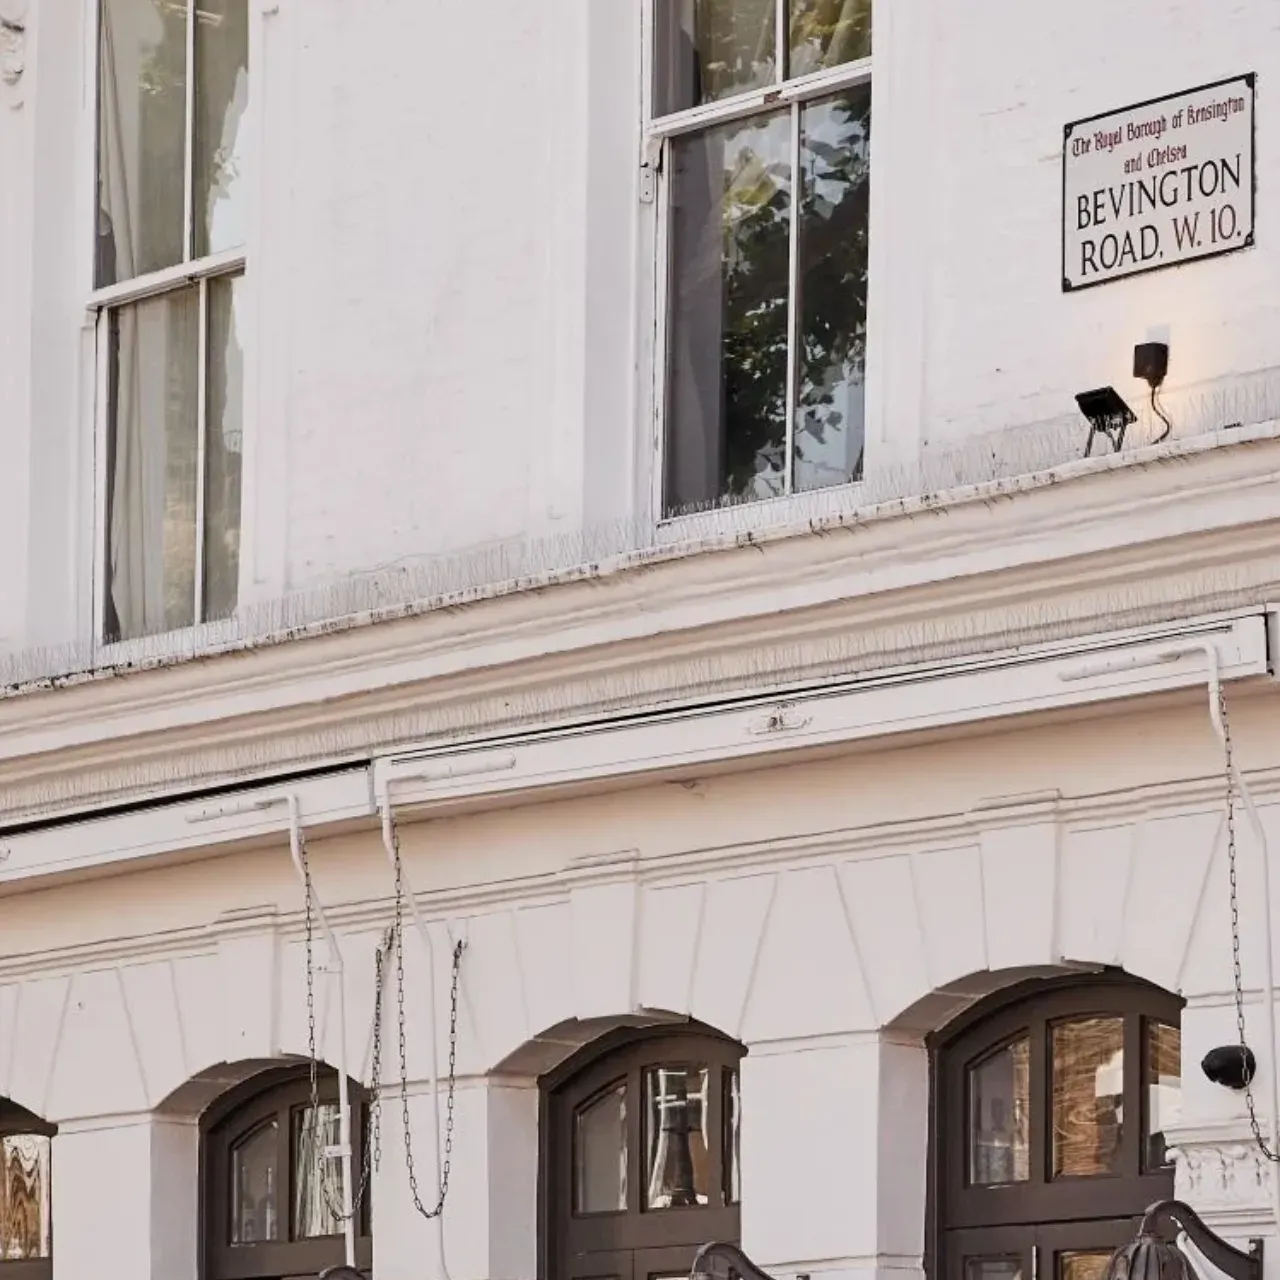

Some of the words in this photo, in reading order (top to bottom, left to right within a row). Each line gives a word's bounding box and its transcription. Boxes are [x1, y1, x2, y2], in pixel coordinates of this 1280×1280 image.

[1072, 137, 1091, 157] The
[1094, 127, 1122, 152] Royal
[1127, 115, 1167, 141] Borough
[1172, 108, 1184, 129] of
[1187, 96, 1245, 125] Kensington
[1124, 153, 1142, 174] and
[1147, 144, 1187, 168] Chelsea
[1076, 154, 1241, 230] BEVINGTON
[1081, 224, 1163, 276] ROAD,
